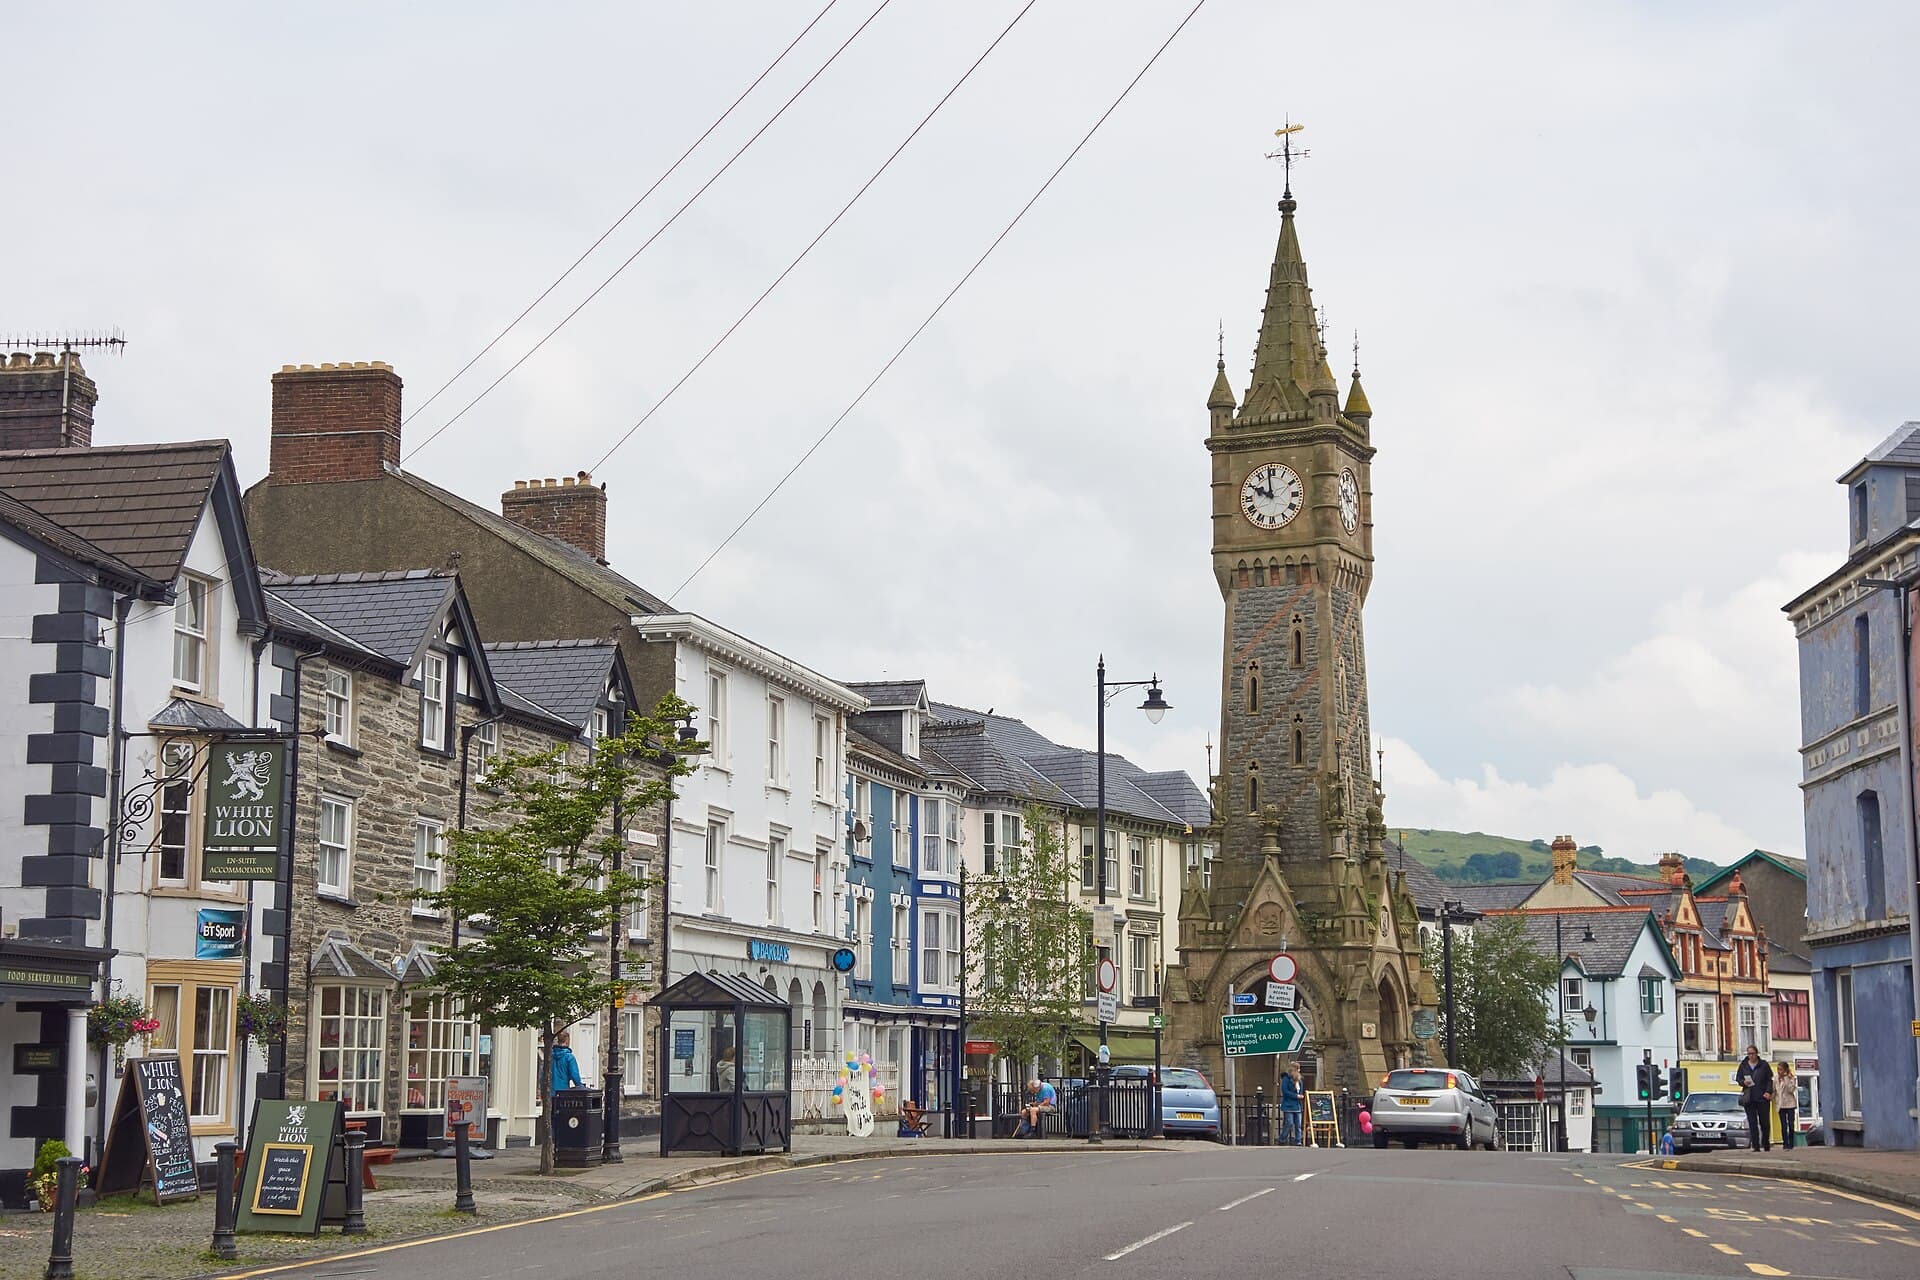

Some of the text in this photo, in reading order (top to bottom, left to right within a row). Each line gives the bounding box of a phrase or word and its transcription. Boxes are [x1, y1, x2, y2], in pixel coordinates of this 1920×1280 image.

[216, 806, 274, 818] WHITE
[214, 819, 273, 837] LION
[203, 924, 235, 939] BT Sport
[760, 942, 790, 963] BARCLAYS
[8, 971, 78, 984] FOOD SERVED ALL DAY
[1230, 1016, 1263, 1024] Drenewydd
[141, 1060, 178, 1078] WHITE
[148, 1078, 173, 1090] LION
[278, 1134, 307, 1142] LION
